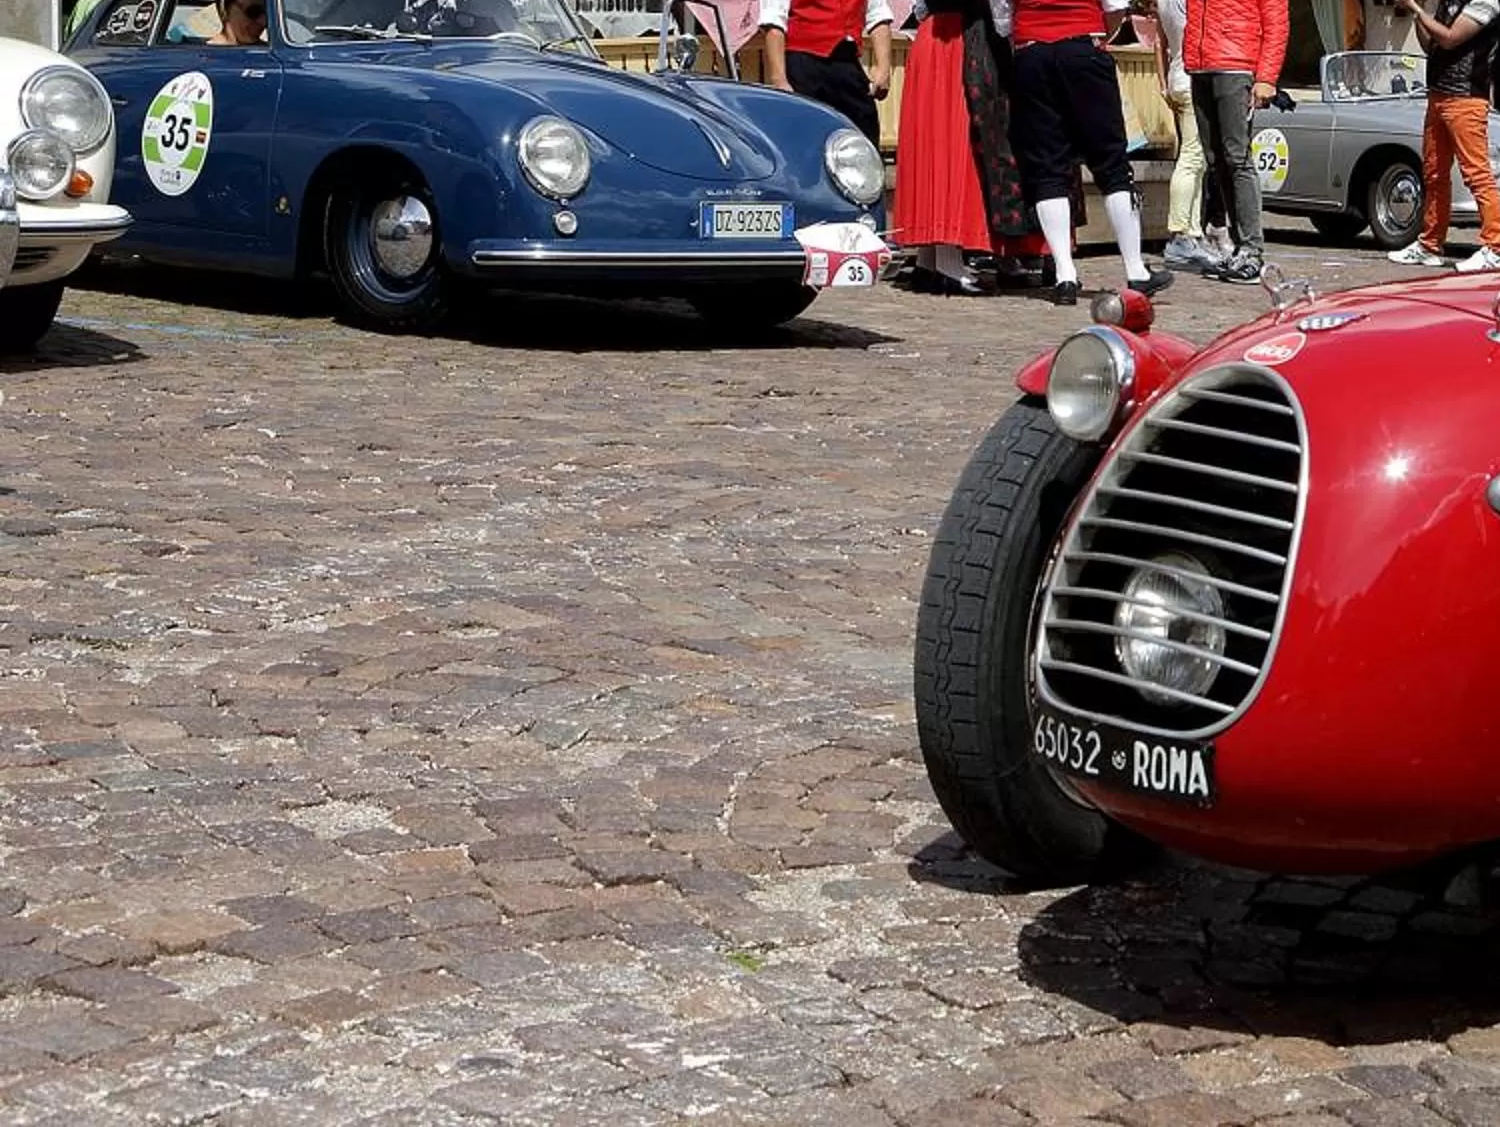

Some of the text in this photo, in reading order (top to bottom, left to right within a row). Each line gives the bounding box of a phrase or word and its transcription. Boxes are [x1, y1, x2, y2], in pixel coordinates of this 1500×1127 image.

[161, 114, 193, 152] 35
[1258, 152, 1277, 171] 52
[847, 265, 865, 282] 35
[1034, 714, 1210, 797] 65032 ROMA
